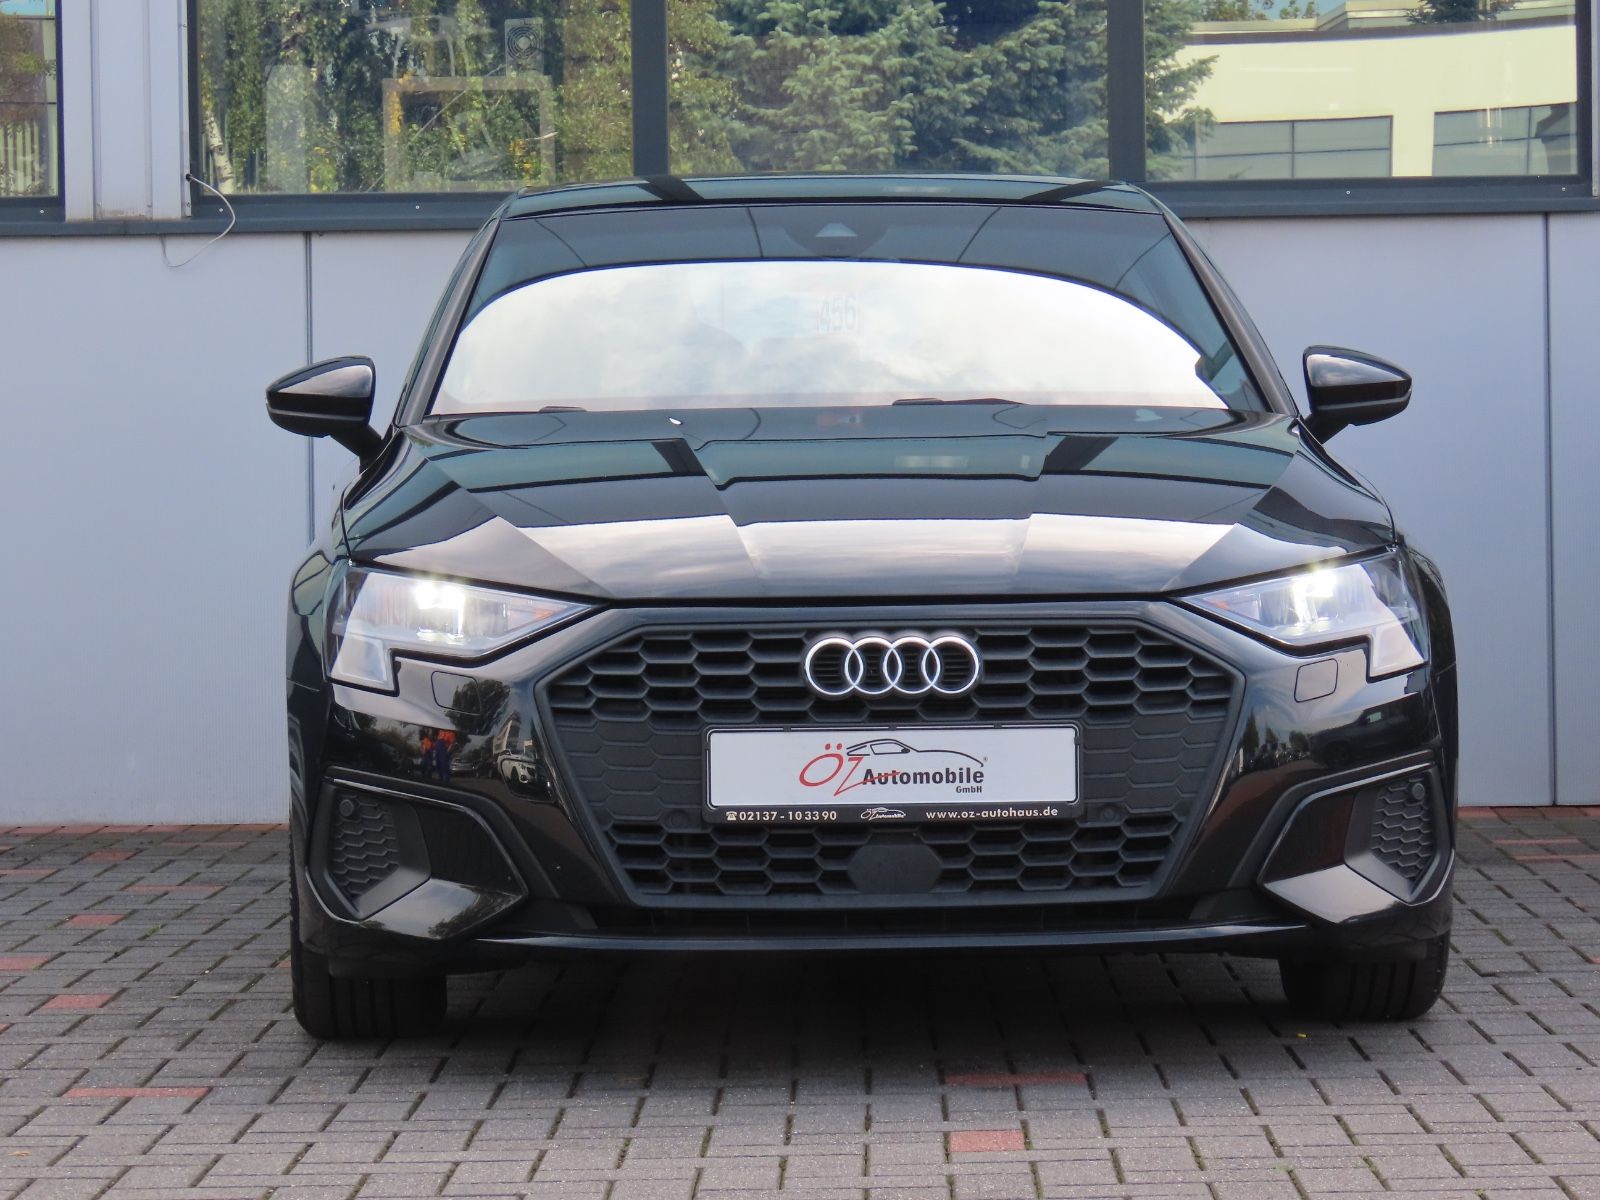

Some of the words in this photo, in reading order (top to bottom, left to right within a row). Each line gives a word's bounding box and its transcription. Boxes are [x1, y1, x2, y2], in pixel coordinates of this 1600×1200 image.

[862, 767, 985, 785] Automobile
[955, 785, 983, 793] GmbH
[925, 806, 1059, 819] www.oz-autohaus.de
